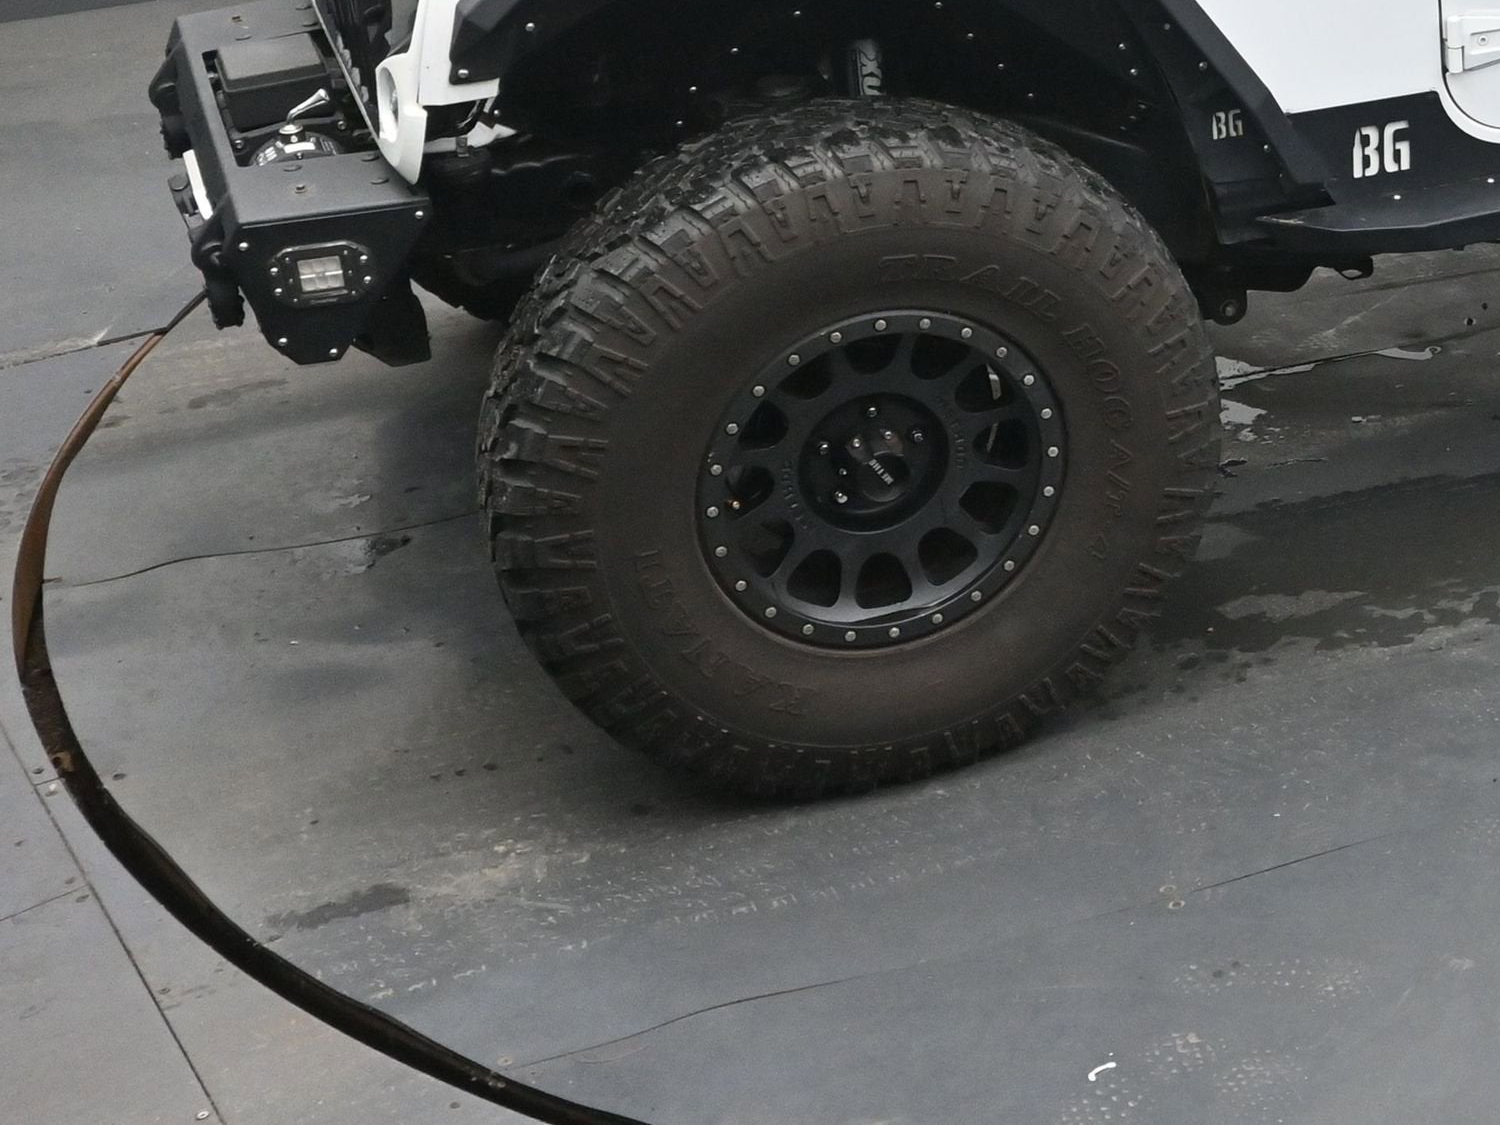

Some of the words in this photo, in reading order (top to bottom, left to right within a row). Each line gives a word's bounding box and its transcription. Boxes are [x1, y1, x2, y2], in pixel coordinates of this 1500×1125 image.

[1212, 109, 1244, 140] BG
[1353, 120, 1411, 179] BG
[879, 253, 1062, 319] TRAIL
[1062, 323, 1134, 431] HOG
